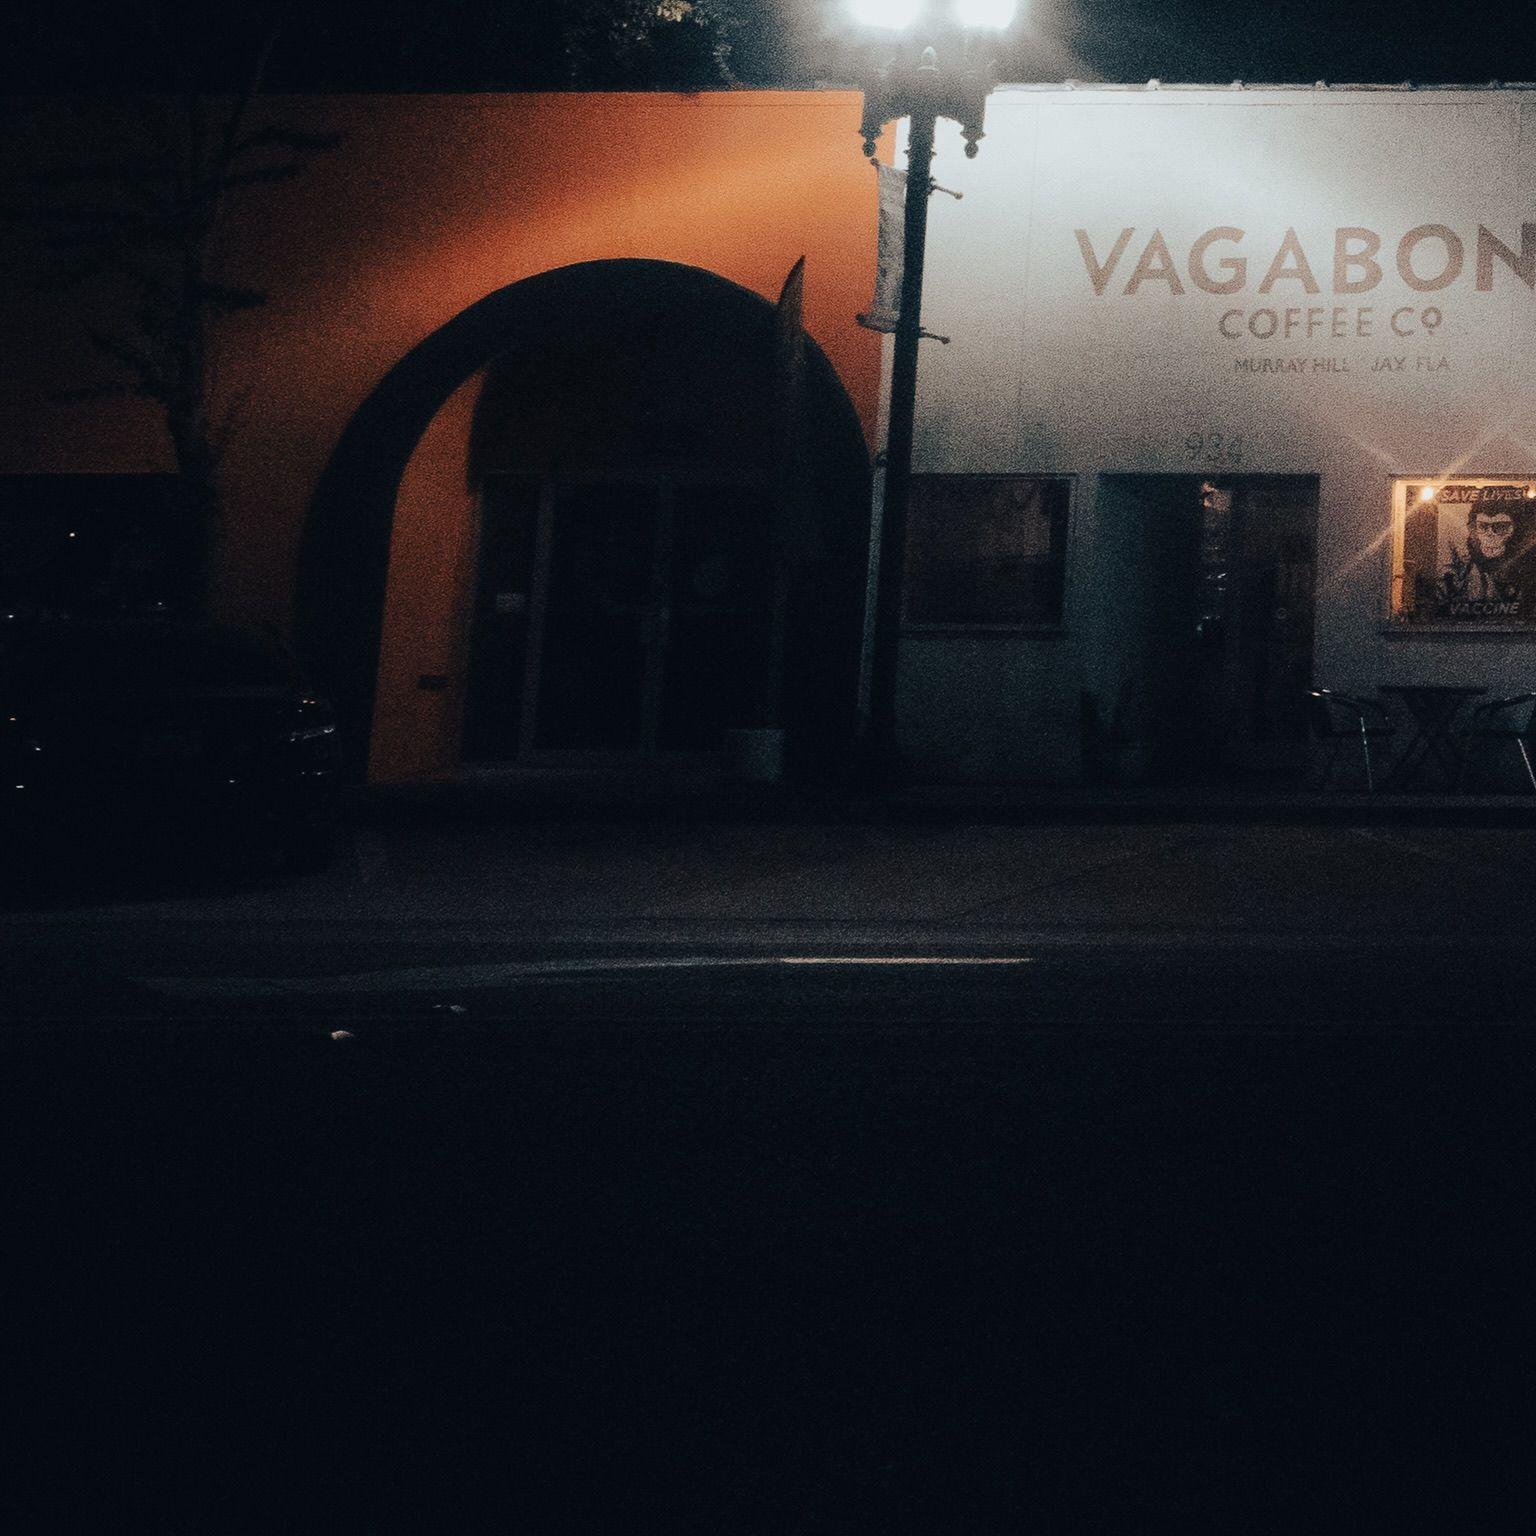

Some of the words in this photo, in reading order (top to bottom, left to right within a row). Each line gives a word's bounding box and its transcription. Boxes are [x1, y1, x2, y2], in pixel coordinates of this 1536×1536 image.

[1218, 307, 1374, 340] COFFEE
[1234, 356, 1306, 373] MURRAY
[1312, 356, 1350, 373] HILL
[1450, 602, 1520, 616] VACCINE
